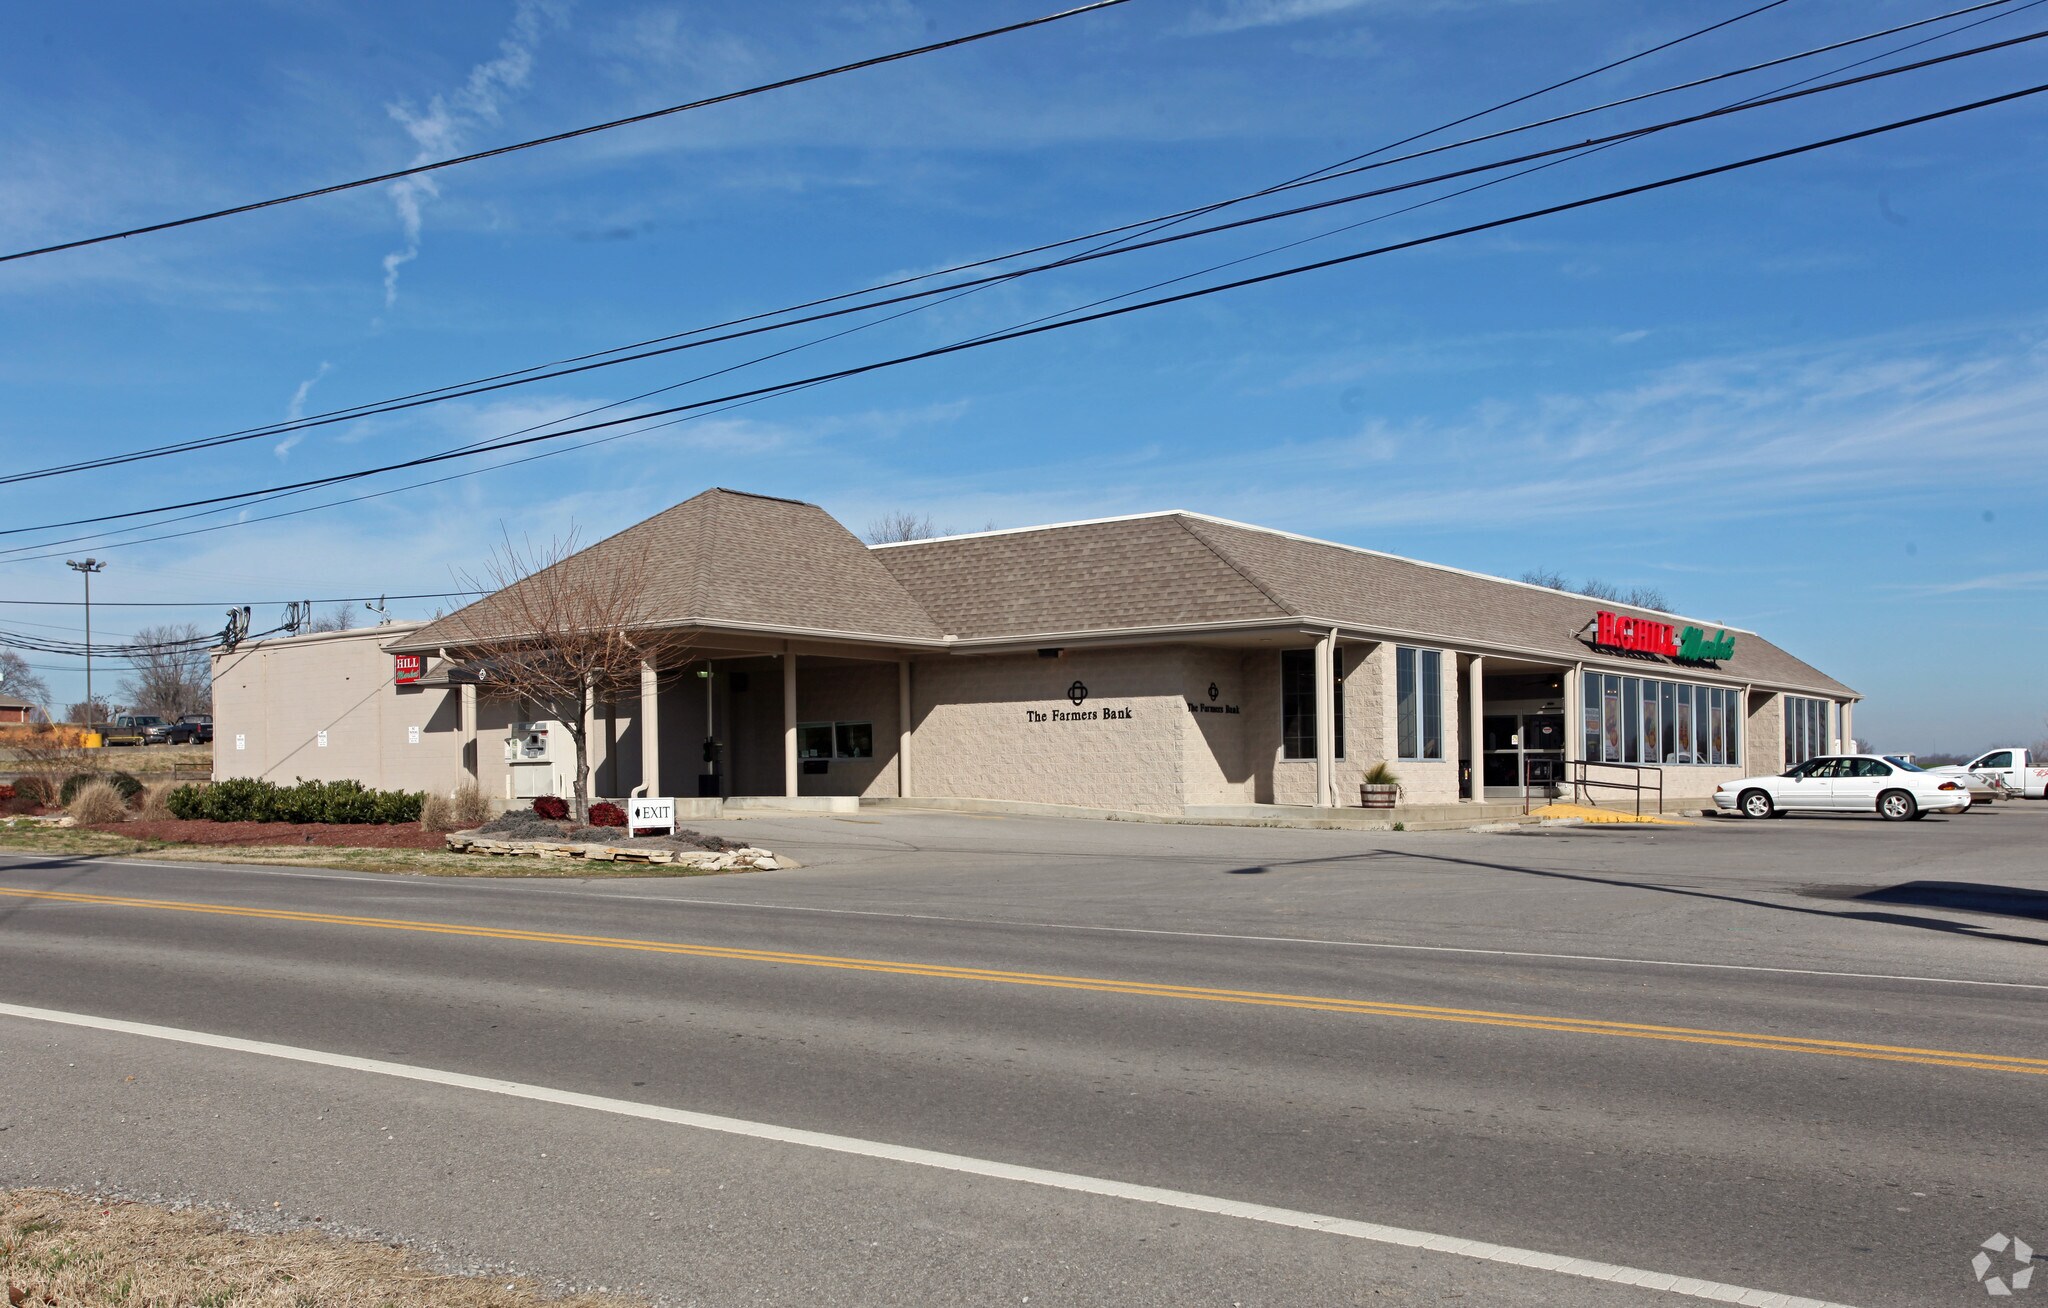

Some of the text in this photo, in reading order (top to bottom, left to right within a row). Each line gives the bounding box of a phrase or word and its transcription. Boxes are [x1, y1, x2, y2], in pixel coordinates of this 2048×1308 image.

[1633, 618, 1677, 656] HILL
[1679, 625, 1736, 661] Market
[396, 657, 419, 669] HILL
[1026, 706, 1133, 722] The Farmers Bank
[1187, 703, 1240, 714] The Farmers Bank
[642, 806, 670, 819] EXIT
